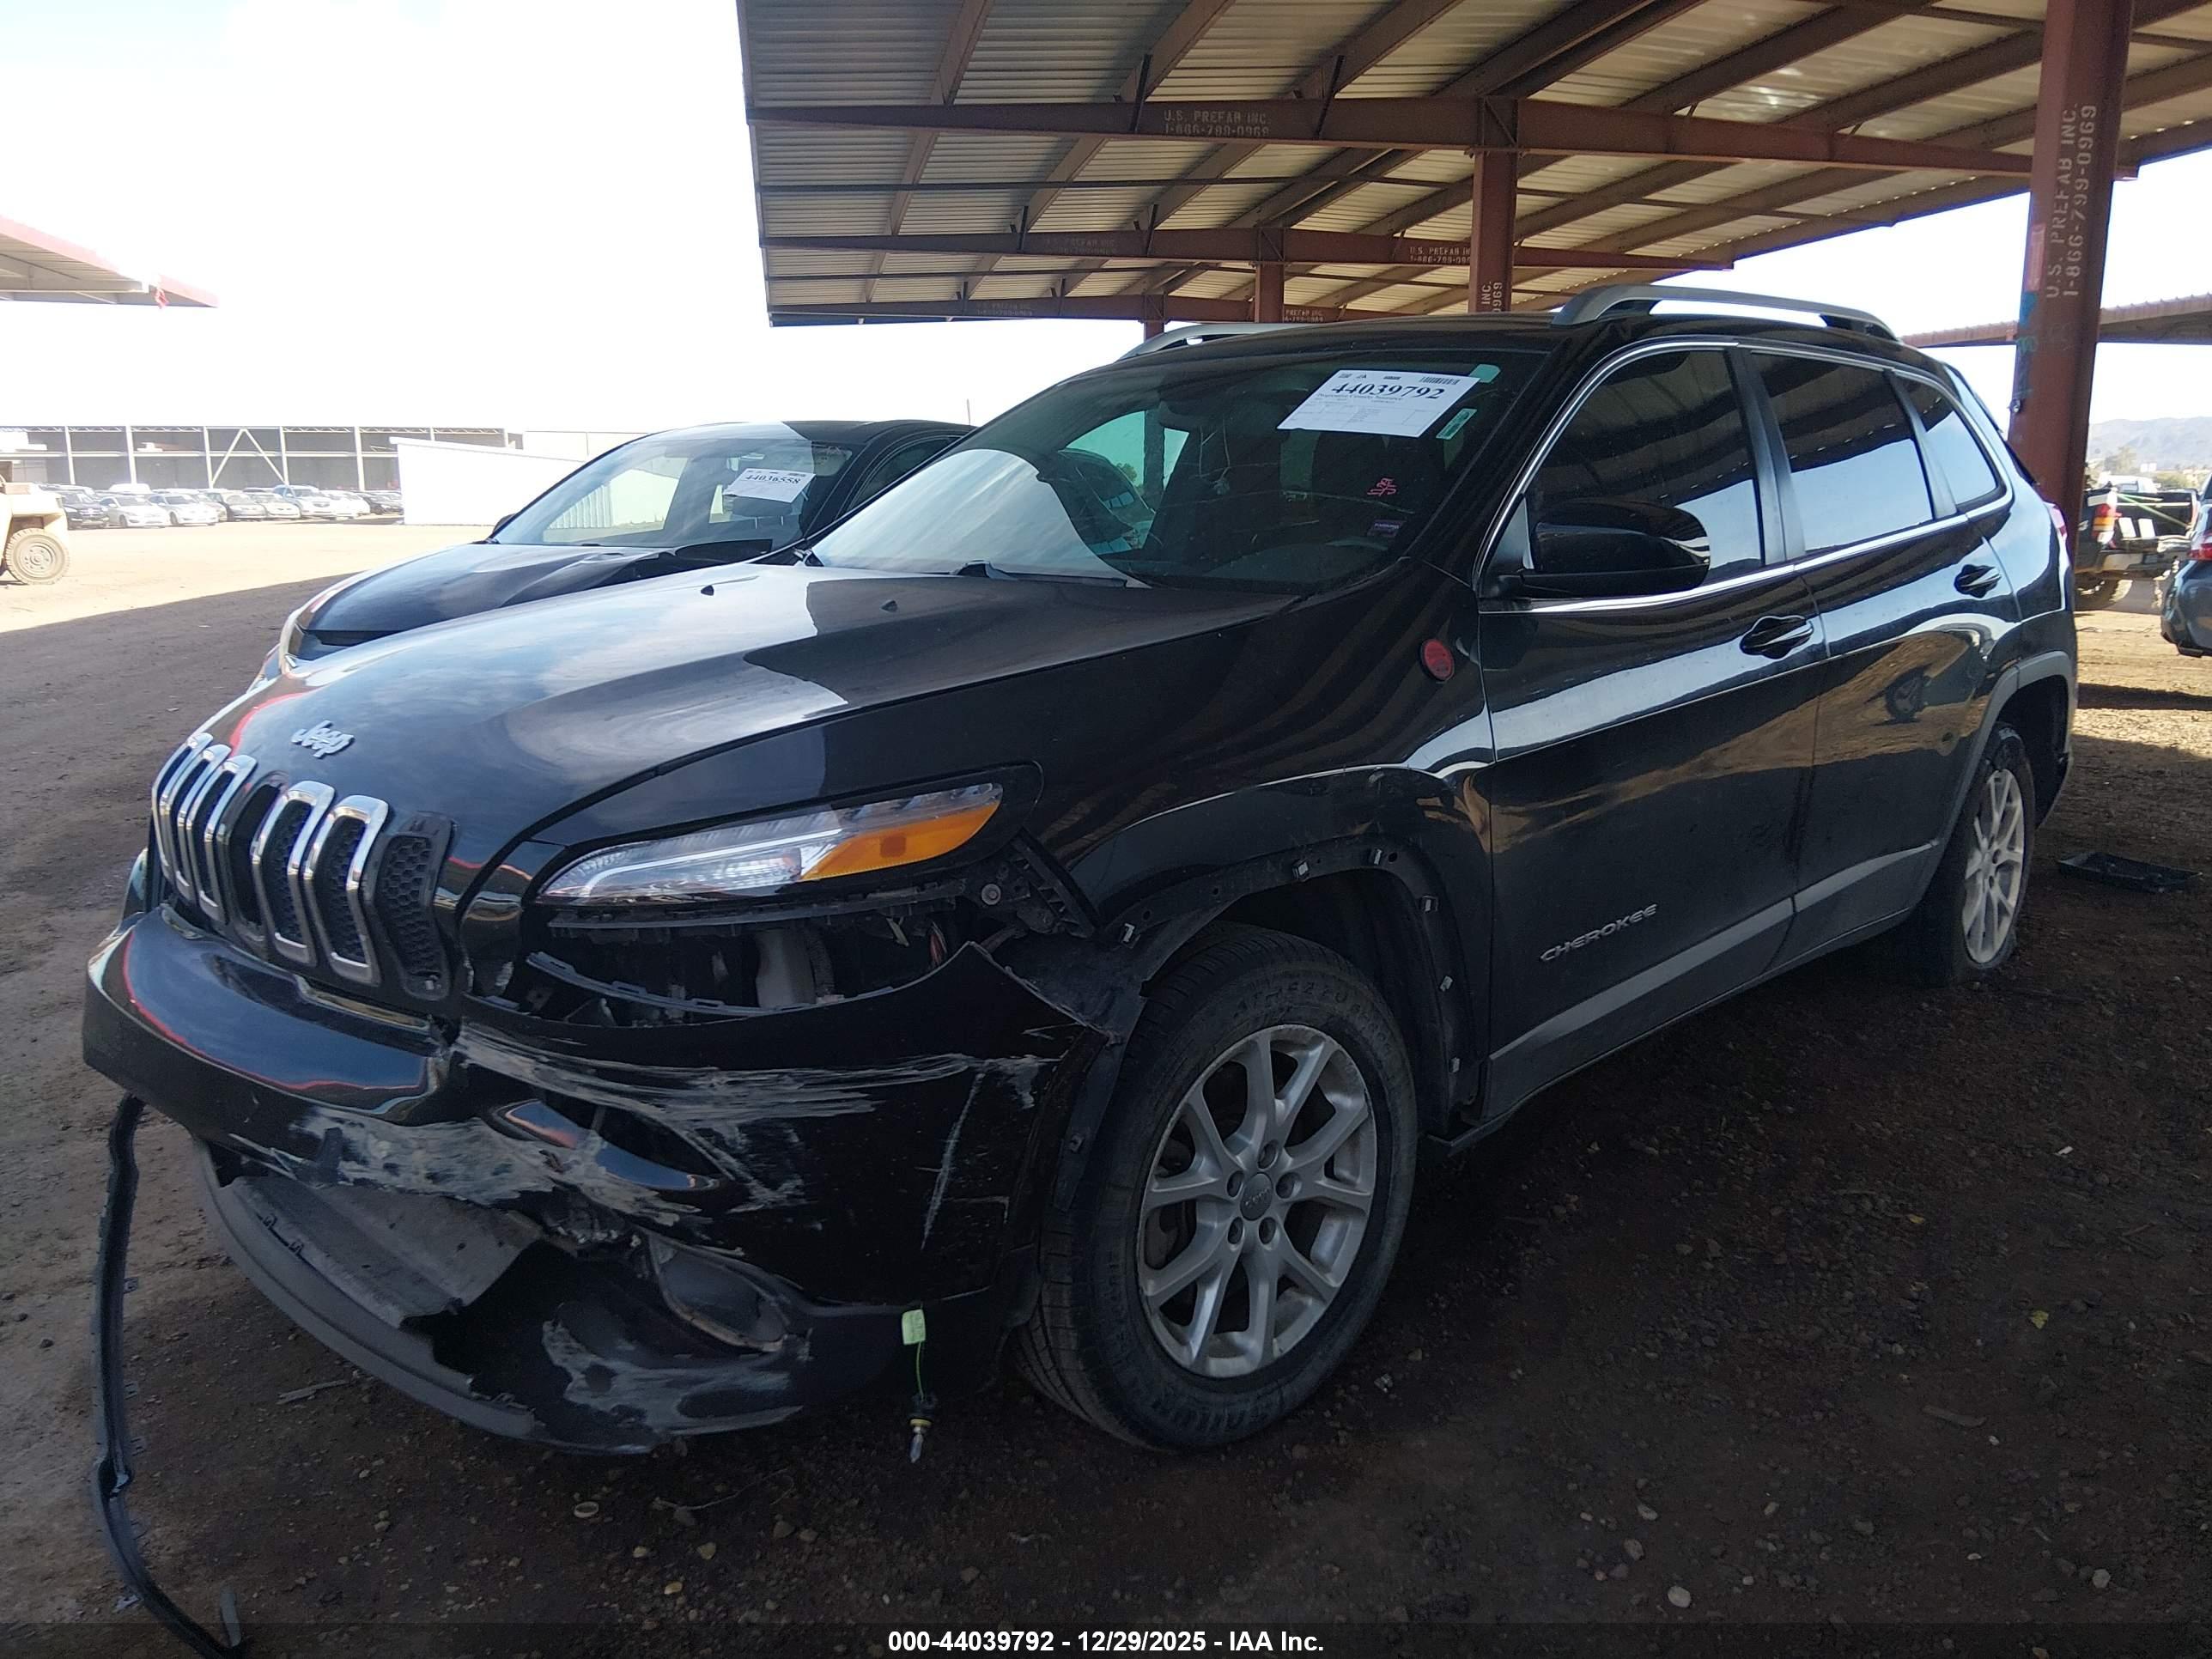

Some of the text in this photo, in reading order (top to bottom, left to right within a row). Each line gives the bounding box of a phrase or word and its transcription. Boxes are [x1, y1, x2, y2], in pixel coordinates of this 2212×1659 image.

[2045, 103, 2078, 298] U.S. PREFAB INC.
[2063, 105, 2097, 296] 1-866-799-0969
[1462, 247, 1471, 256] IN
[1480, 281, 1492, 305] INC.
[1492, 282, 1503, 313] 0969
[1331, 382, 1446, 400] 44039792
[290, 720, 355, 758] Jeep
[1539, 903, 1658, 962] CHEROKEE
